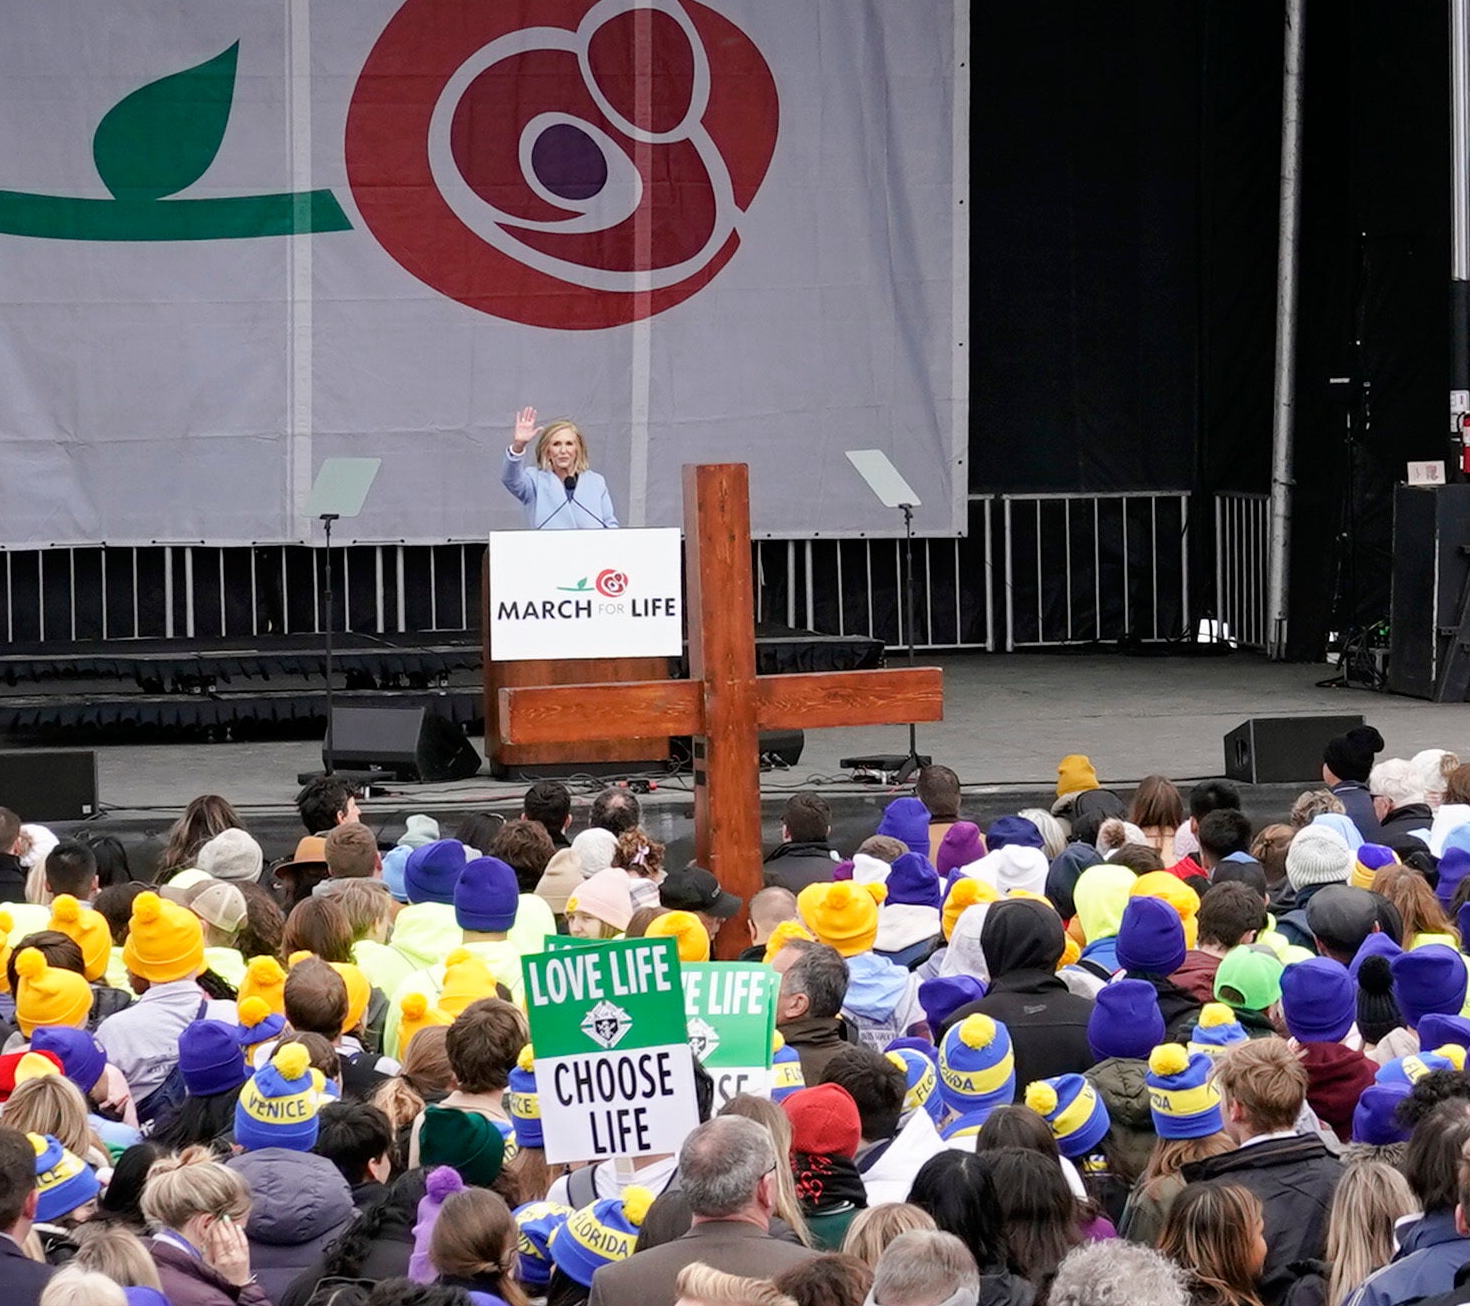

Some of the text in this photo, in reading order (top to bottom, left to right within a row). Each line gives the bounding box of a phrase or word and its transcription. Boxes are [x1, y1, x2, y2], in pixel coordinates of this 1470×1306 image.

[498, 597, 676, 620] MARCH FOR LIFE
[529, 944, 673, 1007] LOVE LIFE
[711, 971, 766, 1015] LIFE
[554, 1051, 675, 1107] CHOOSE
[248, 1093, 307, 1118] VENICE
[588, 1106, 651, 1155] LIFE
[573, 1211, 629, 1258] FLORIDA
